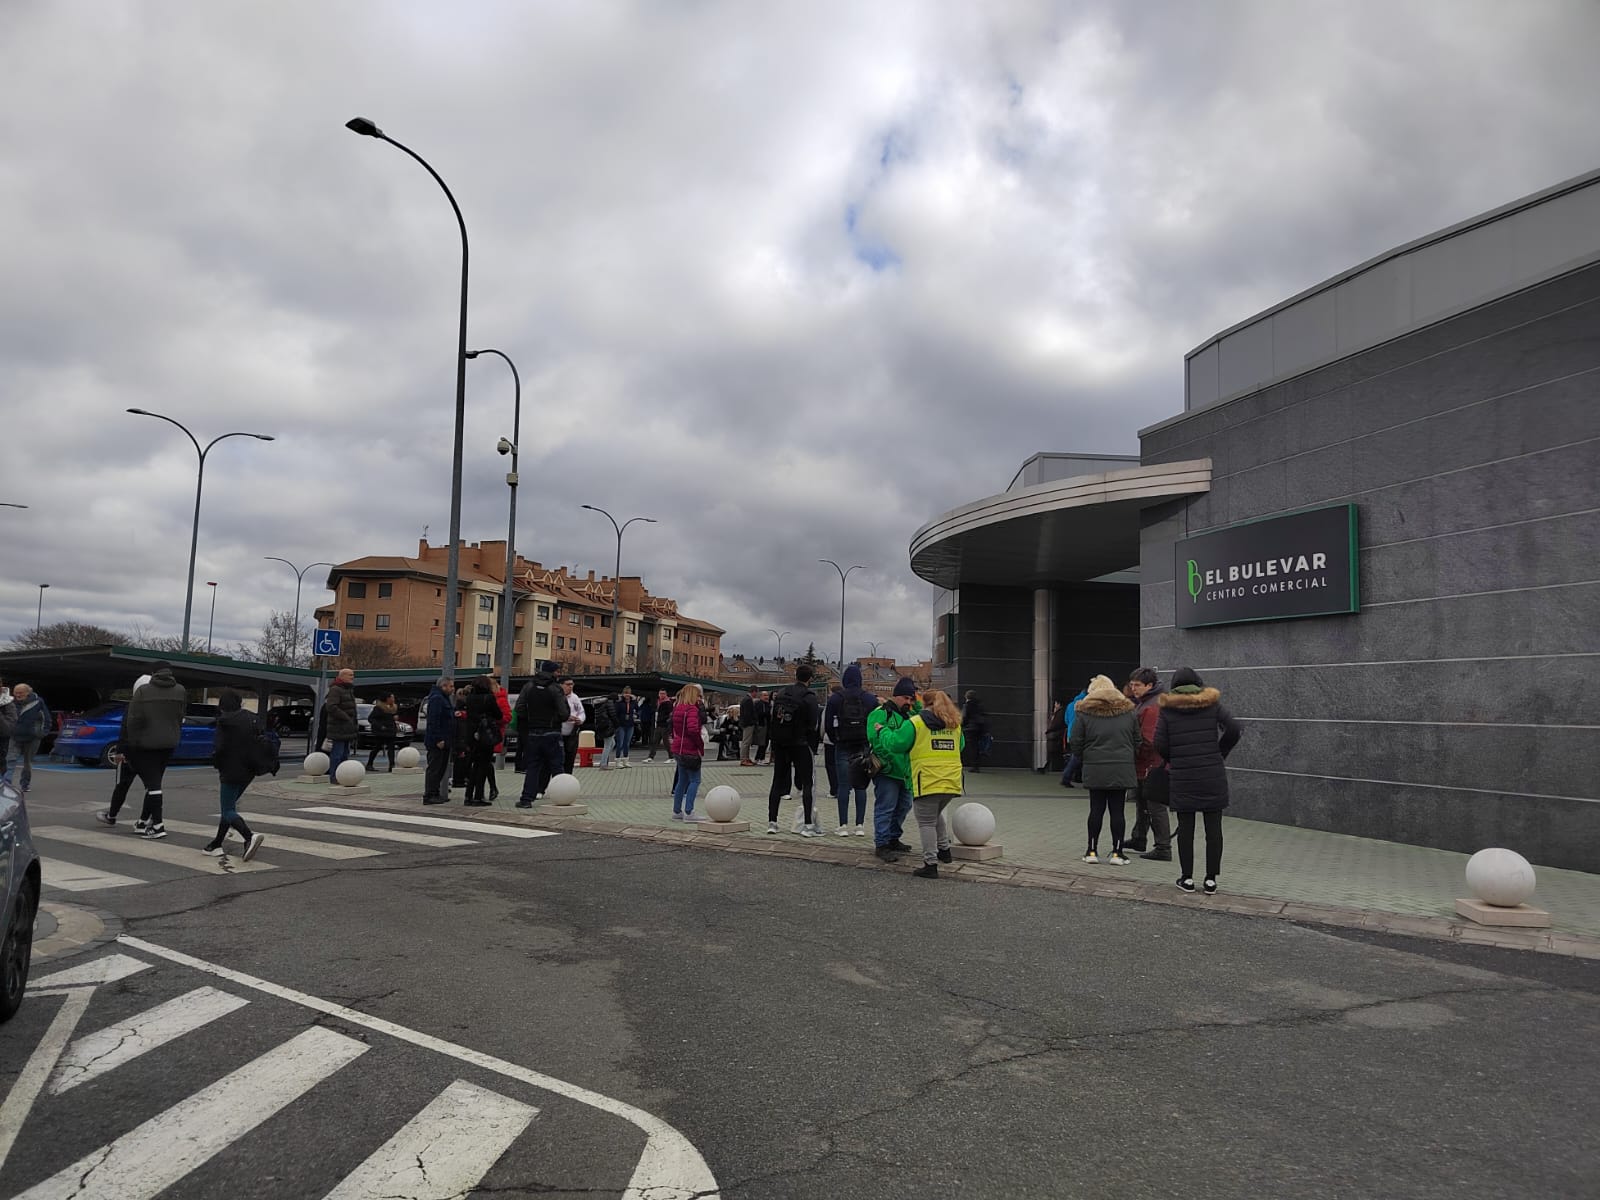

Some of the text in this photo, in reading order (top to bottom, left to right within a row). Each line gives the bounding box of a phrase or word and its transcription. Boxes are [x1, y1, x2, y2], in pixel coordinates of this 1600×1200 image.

[1206, 553, 1327, 586] EL BULEVAR
[1206, 577, 1328, 601] CENTRO COMERCIAL
